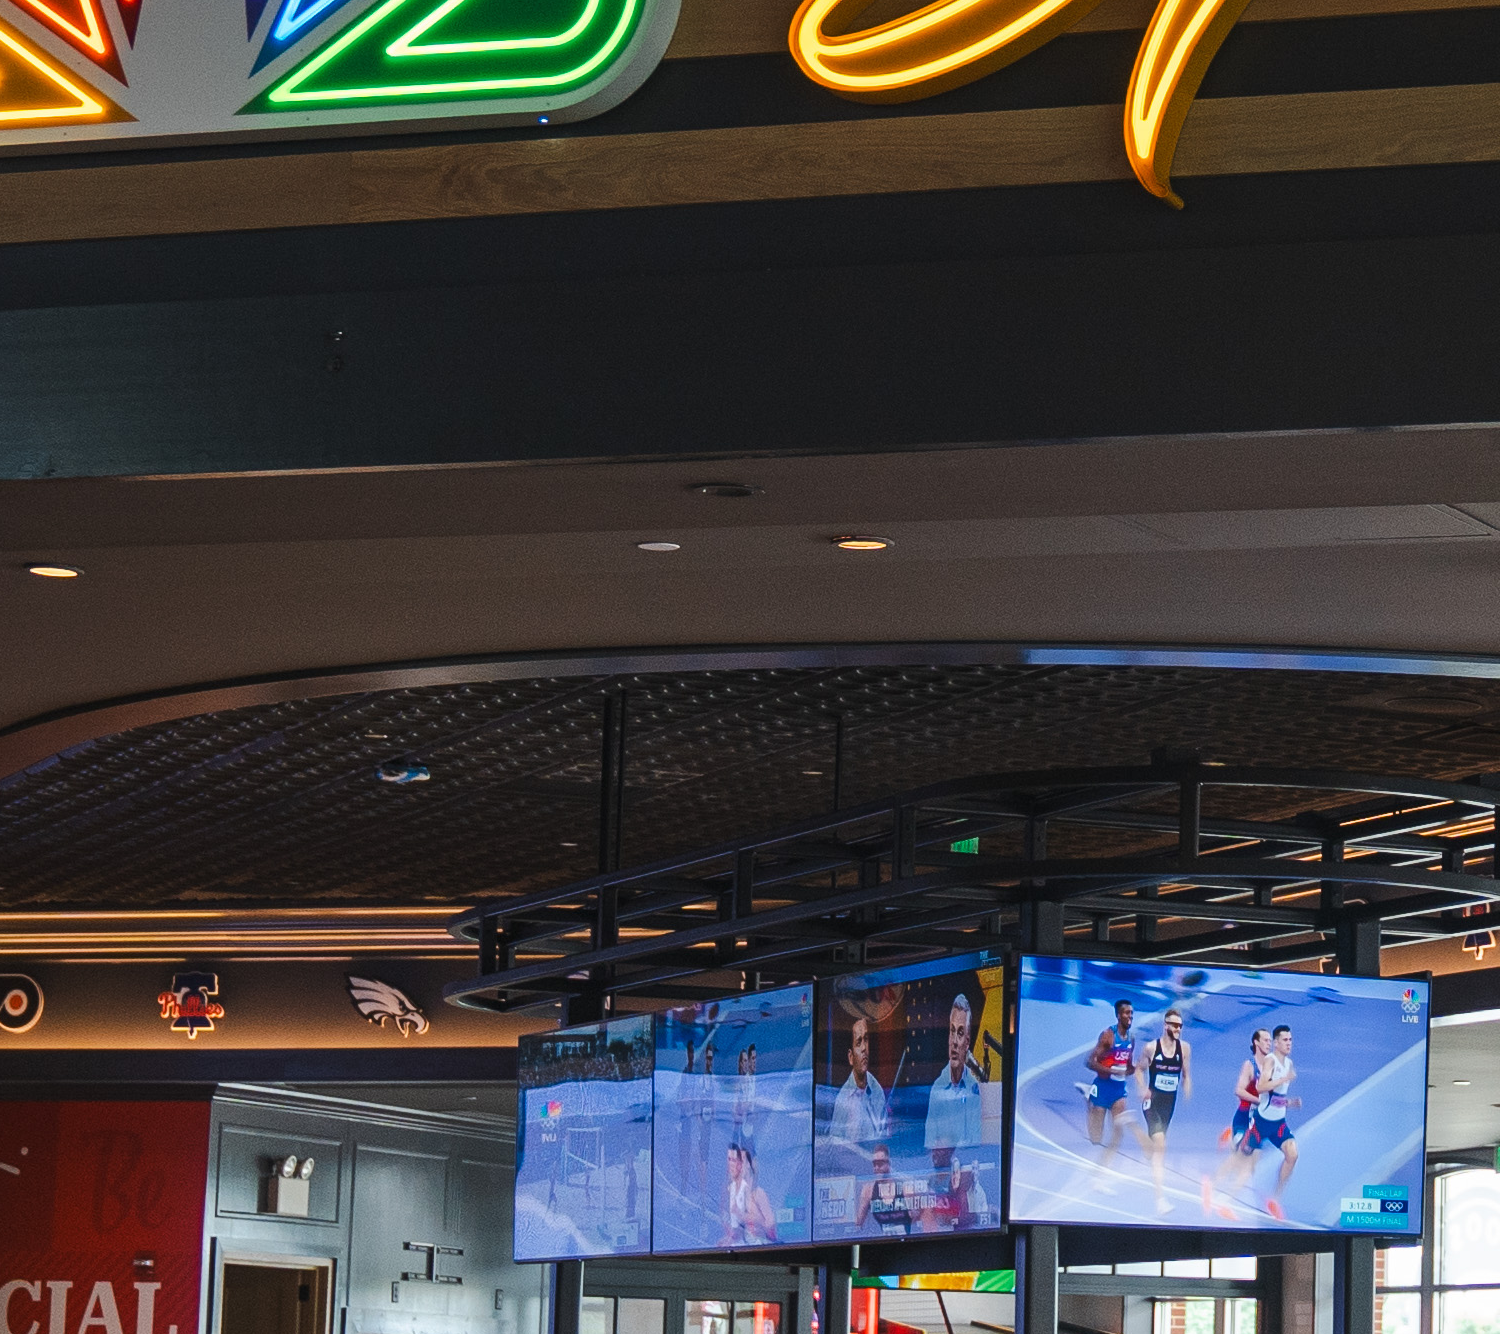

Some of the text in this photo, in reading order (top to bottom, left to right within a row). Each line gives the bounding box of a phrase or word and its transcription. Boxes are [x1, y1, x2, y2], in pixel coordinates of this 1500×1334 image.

[157, 991, 225, 1019] Phillies
[1402, 1014, 1419, 1024] LIVE
[1368, 1188, 1387, 1197] FINAL
